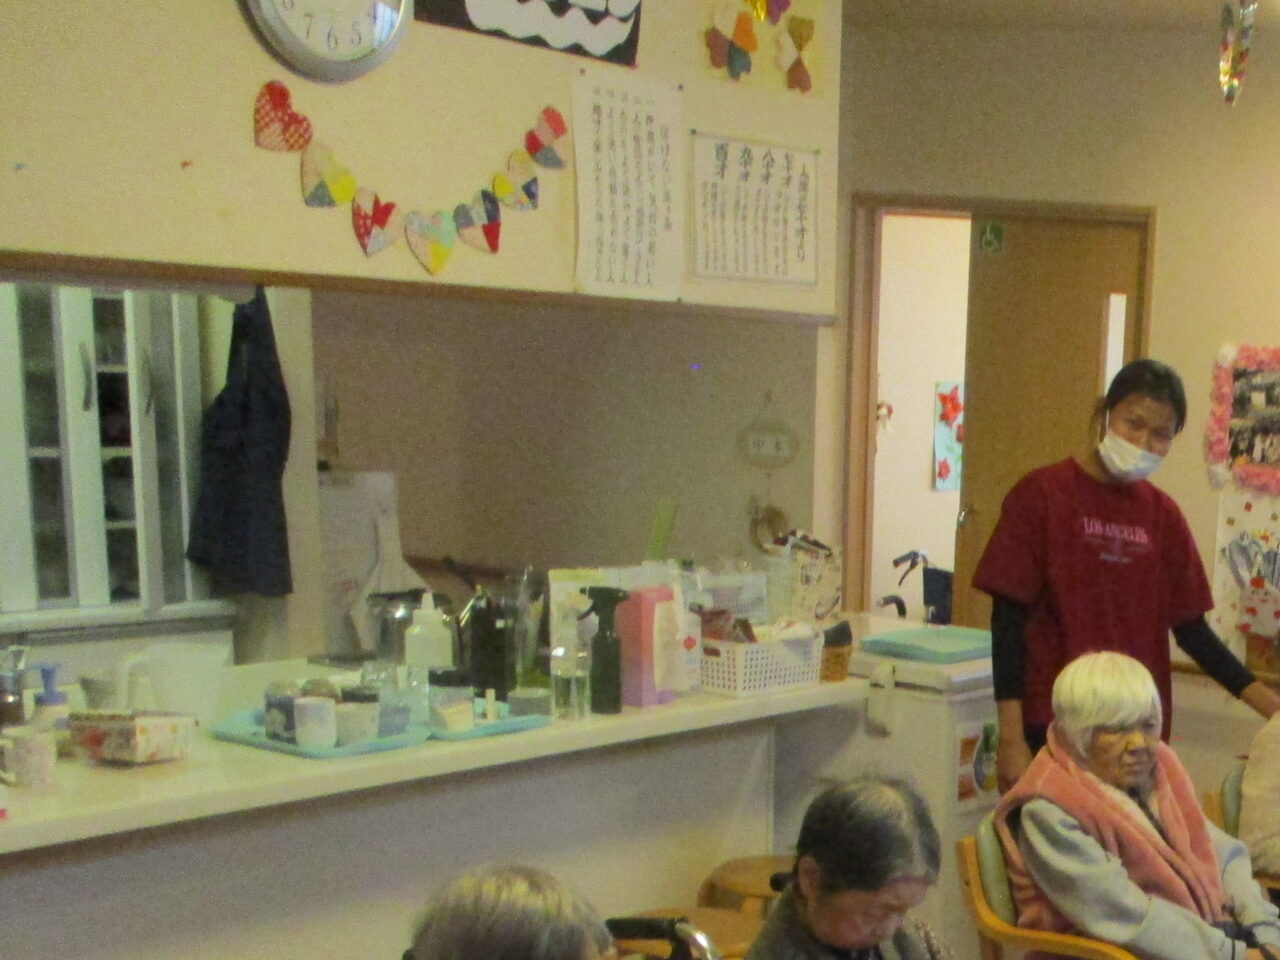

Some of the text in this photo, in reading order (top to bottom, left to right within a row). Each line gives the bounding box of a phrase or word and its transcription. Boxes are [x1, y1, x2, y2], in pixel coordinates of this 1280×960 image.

[304, 13, 314, 39] 7
[326, 26, 339, 50] 6
[350, 21, 362, 46] 5
